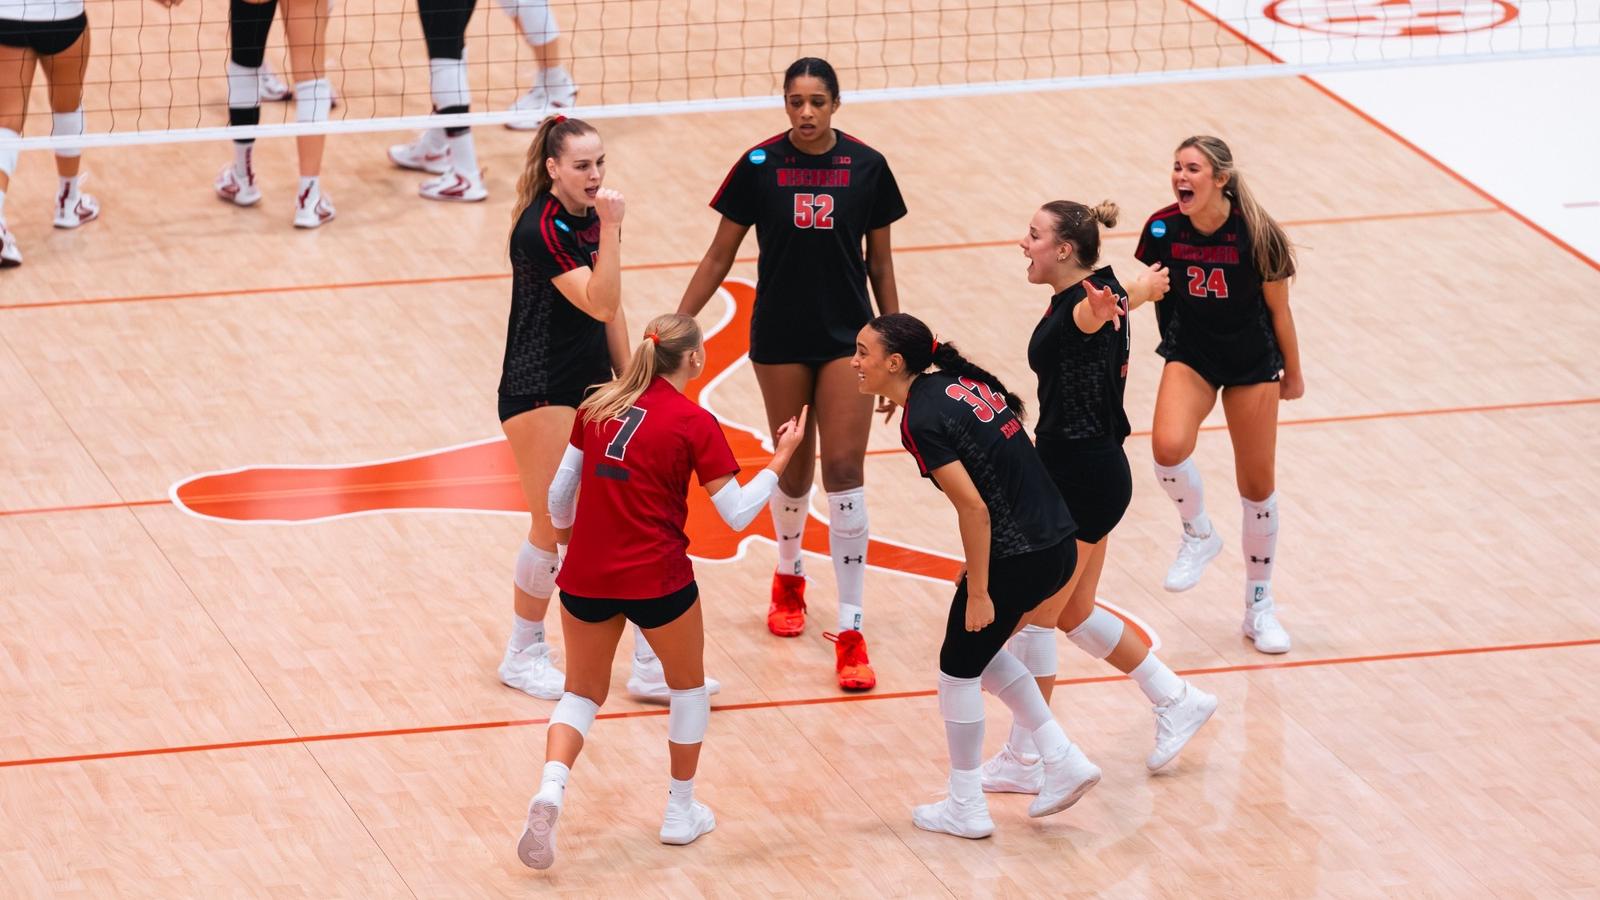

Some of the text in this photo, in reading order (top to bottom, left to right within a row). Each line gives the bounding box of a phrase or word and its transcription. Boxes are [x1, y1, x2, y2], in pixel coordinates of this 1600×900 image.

[776, 168, 851, 187] WISCONSIN
[794, 192, 834, 229] 52
[1187, 265, 1229, 298] 24
[945, 375, 1008, 423] 32
[605, 405, 648, 461] 7
